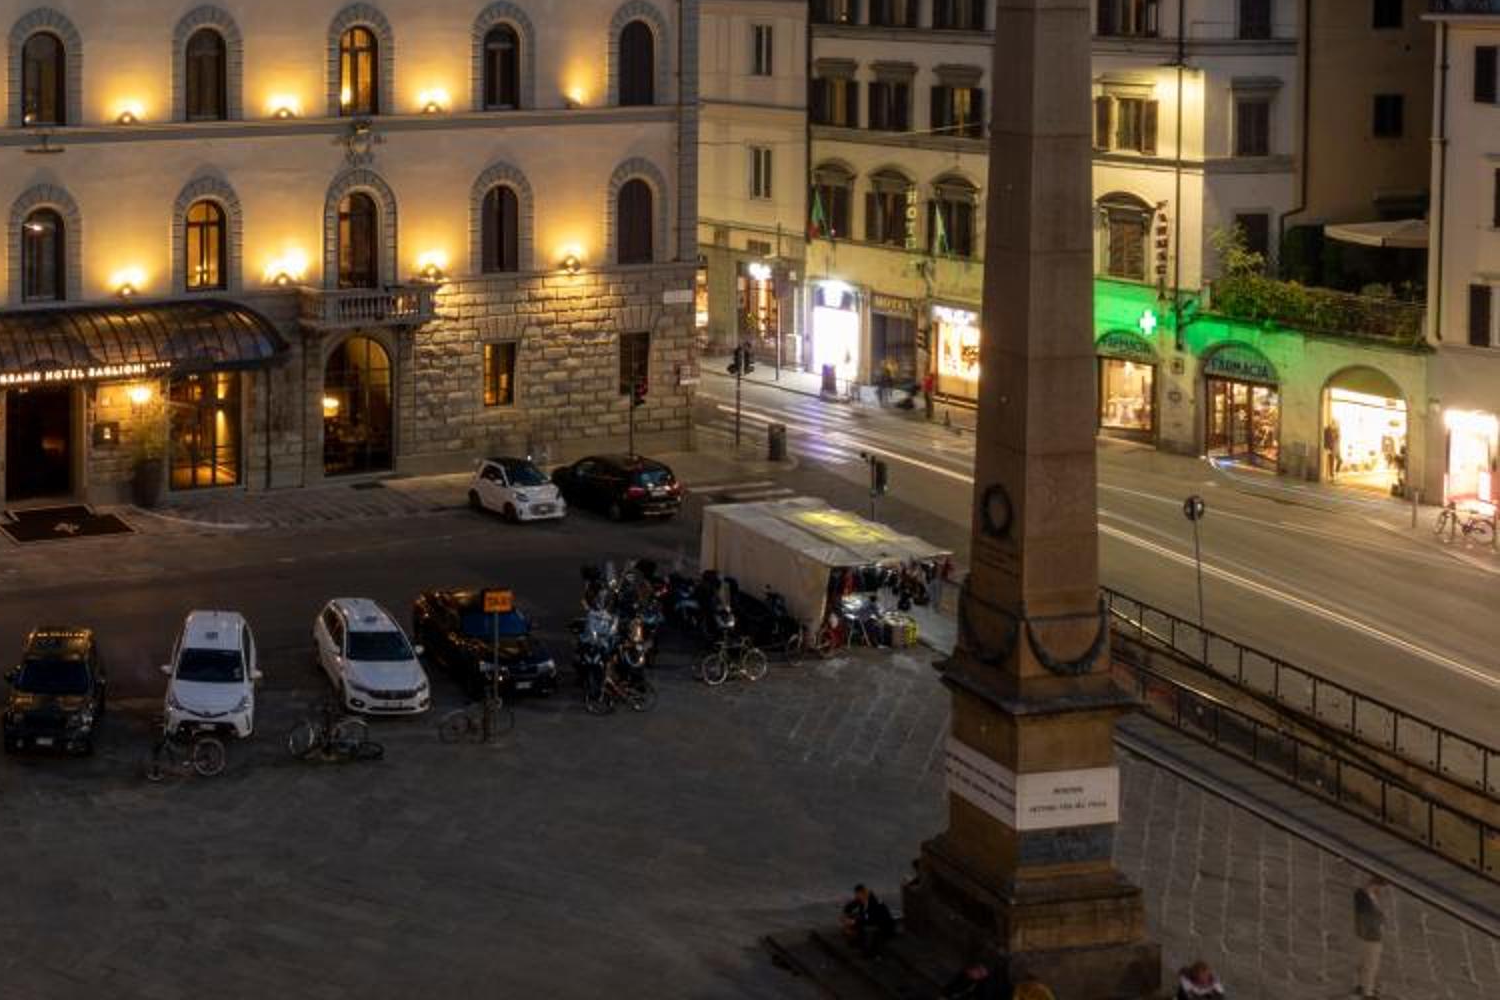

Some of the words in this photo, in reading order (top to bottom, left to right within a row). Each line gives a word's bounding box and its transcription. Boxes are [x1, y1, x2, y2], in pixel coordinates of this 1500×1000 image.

[45, 367, 84, 380] HOTEL
[88, 363, 147, 377] BAGLIONI
[1212, 359, 1269, 377] FARMACIA
